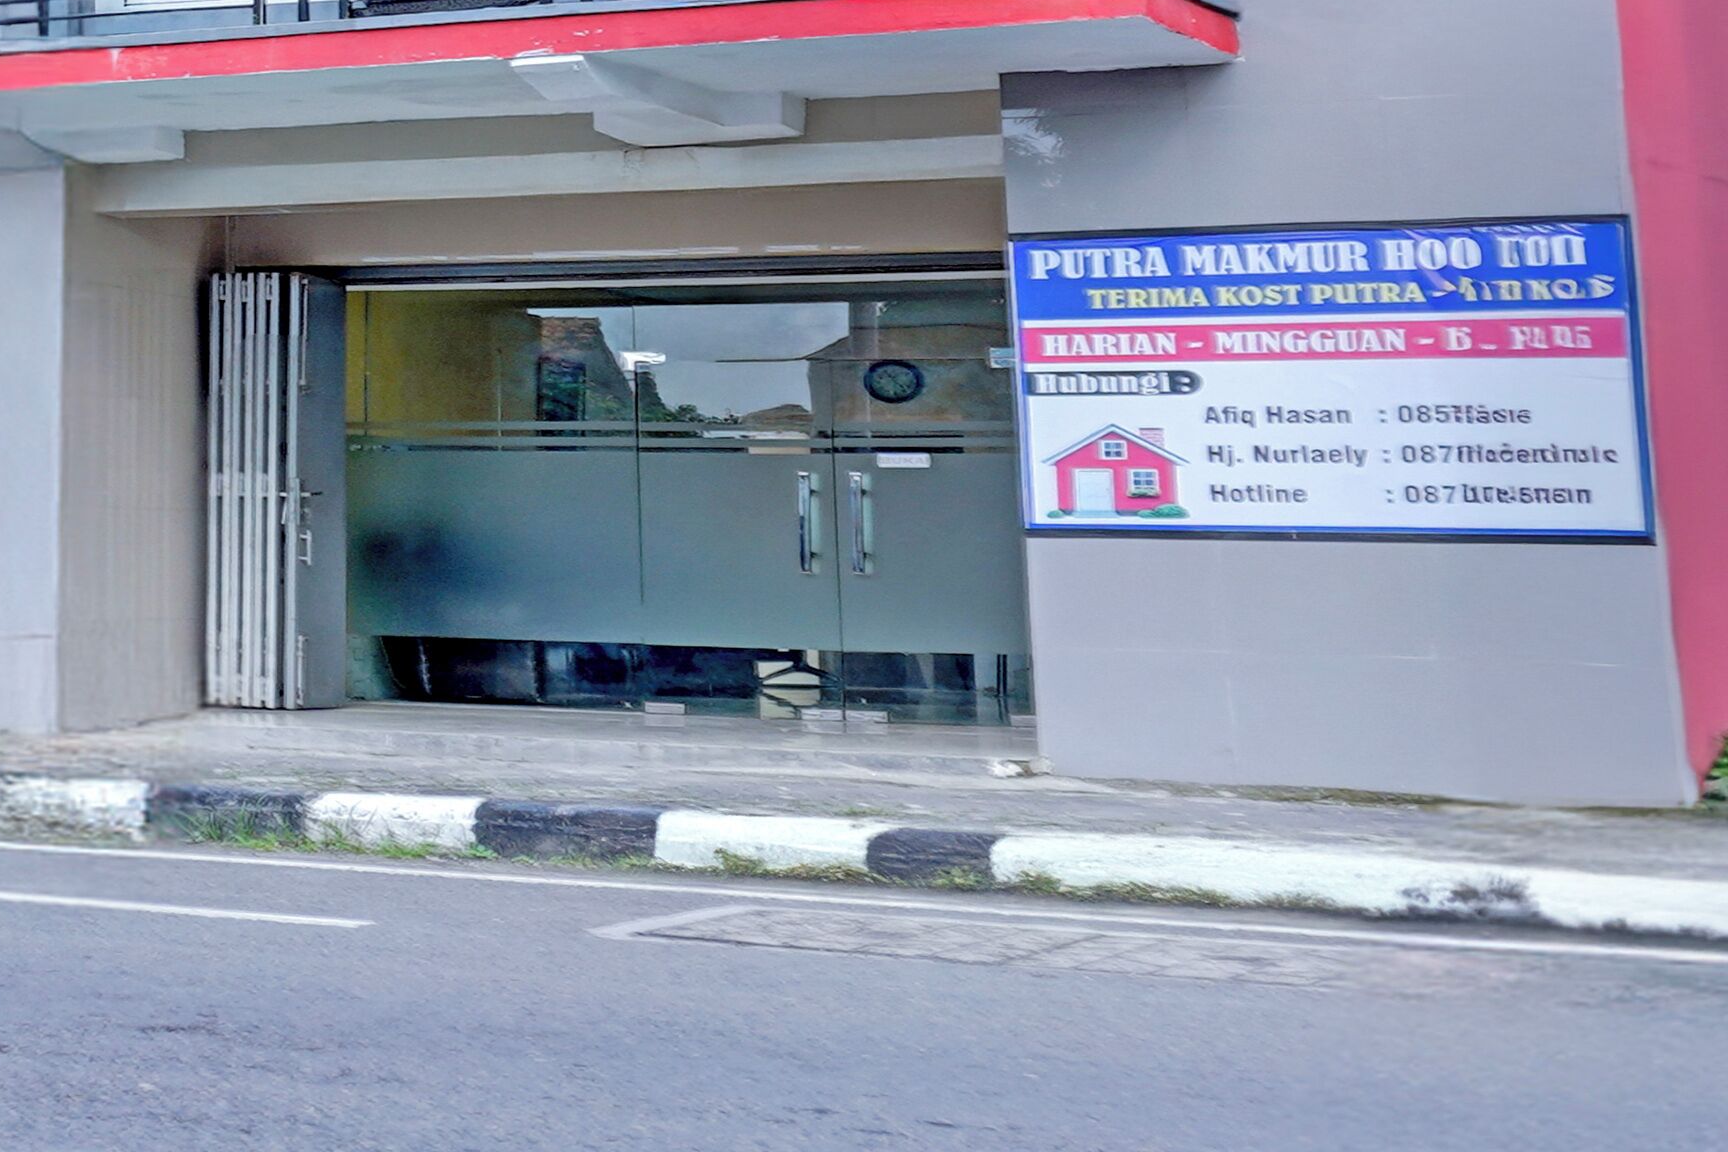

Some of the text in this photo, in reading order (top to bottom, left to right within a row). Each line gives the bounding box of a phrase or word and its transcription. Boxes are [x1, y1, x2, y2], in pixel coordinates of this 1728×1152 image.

[1029, 246, 1171, 279] PUTRA
[1182, 239, 1369, 277] MAKMUR
[1087, 287, 1210, 309] TERIMA
[1216, 284, 1301, 307] KOST
[1310, 281, 1427, 304] PUTRA
[1042, 332, 1177, 357] HARIAN
[1214, 328, 1407, 355] MINGGUAN
[1035, 371, 1172, 395] Hubungi
[1204, 406, 1256, 428] Afiq
[1266, 405, 1352, 424] Hasan
[1207, 445, 1243, 467] Hj.
[1253, 445, 1368, 468] Nurlaely
[1210, 484, 1309, 504] Hotline
